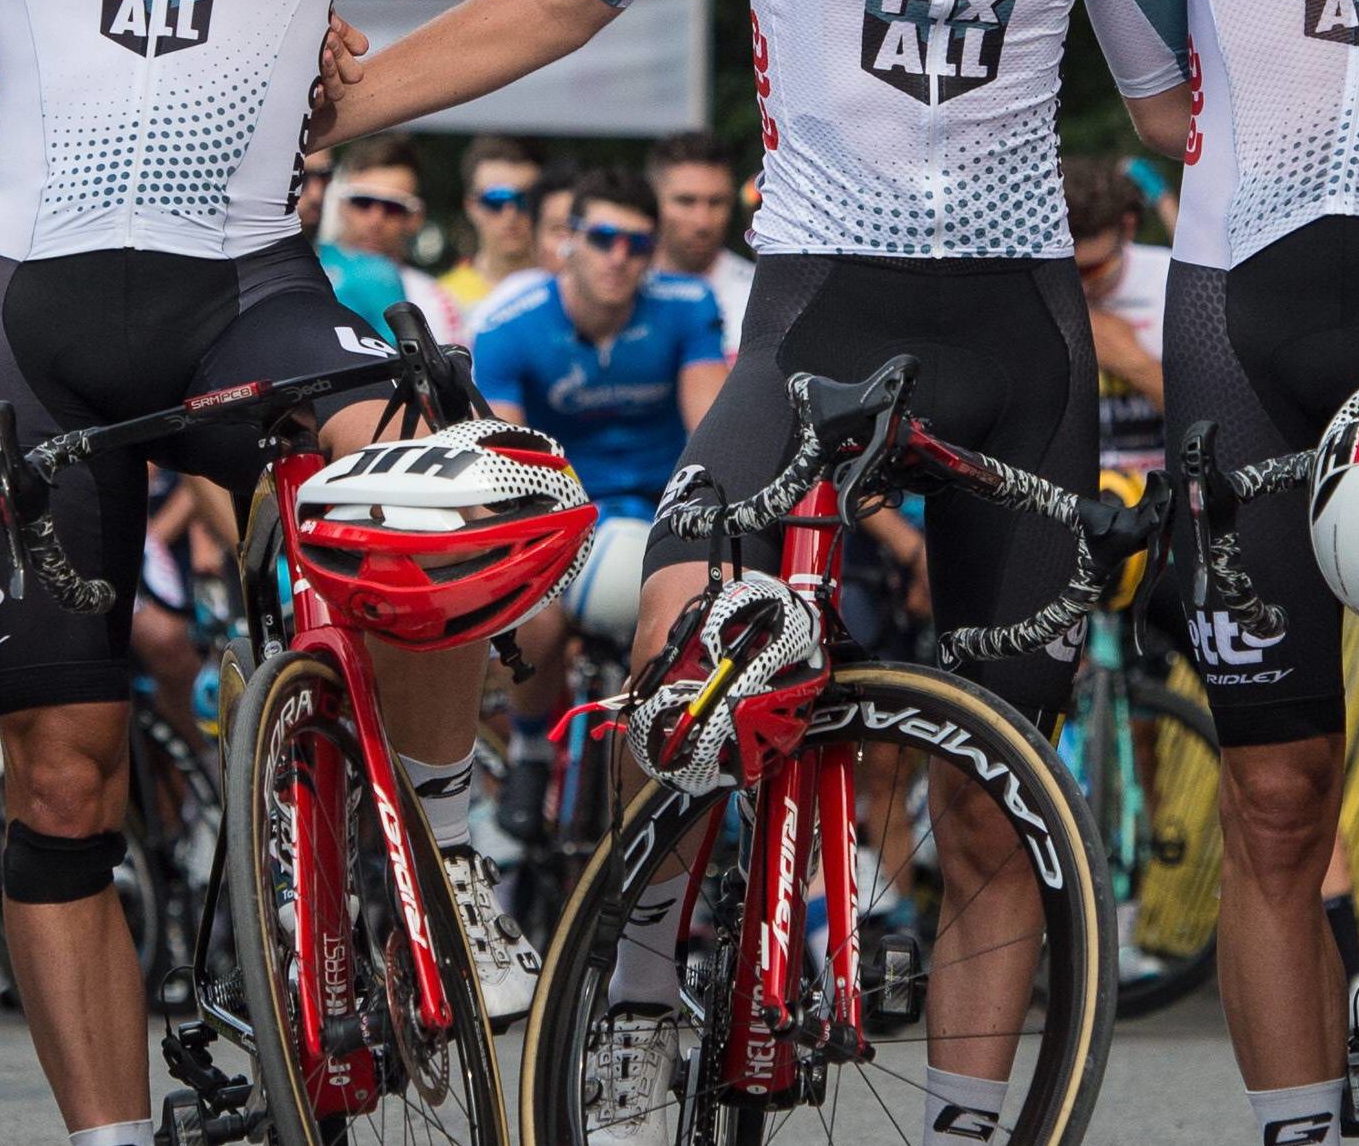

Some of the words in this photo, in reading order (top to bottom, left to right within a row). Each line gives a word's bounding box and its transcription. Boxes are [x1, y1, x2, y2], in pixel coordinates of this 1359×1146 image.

[873, 19, 990, 80] ALL
[191, 395, 220, 411] SRM
[1206, 668, 1296, 686] RIDLEY
[372, 782, 428, 949] RIDLEY
[772, 796, 799, 961] RIDLEY
[323, 933, 347, 984] FAST
